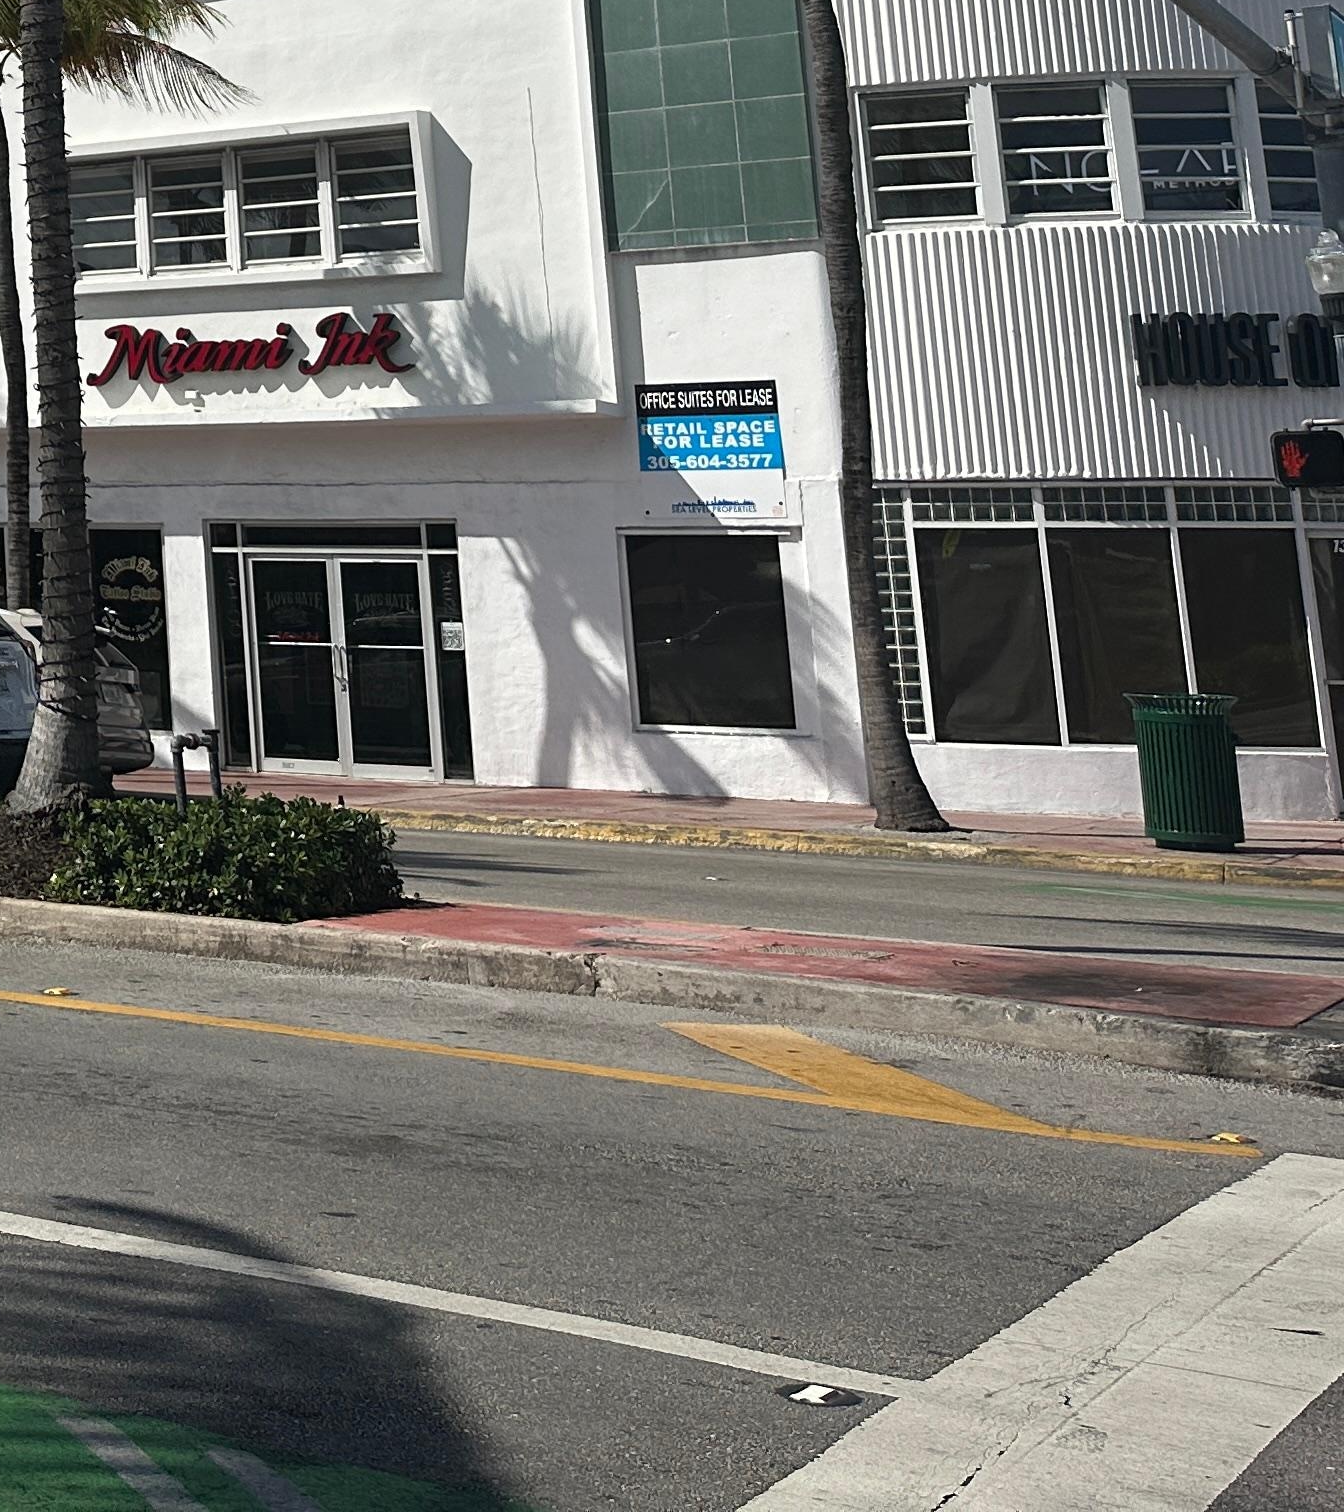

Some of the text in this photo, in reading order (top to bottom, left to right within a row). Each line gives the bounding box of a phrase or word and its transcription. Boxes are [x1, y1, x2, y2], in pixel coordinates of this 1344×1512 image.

[87, 312, 416, 386] Miami Ink
[1131, 312, 1289, 387] HOUSE
[640, 388, 774, 409] OFFICE SUITES FOR LEASE
[641, 420, 776, 436] RETAIL SPACE
[653, 434, 765, 449] FOR LEASE
[648, 454, 773, 469] 305-604-3577
[672, 505, 688, 513] SEA
[712, 504, 757, 513] PROPERTIES
